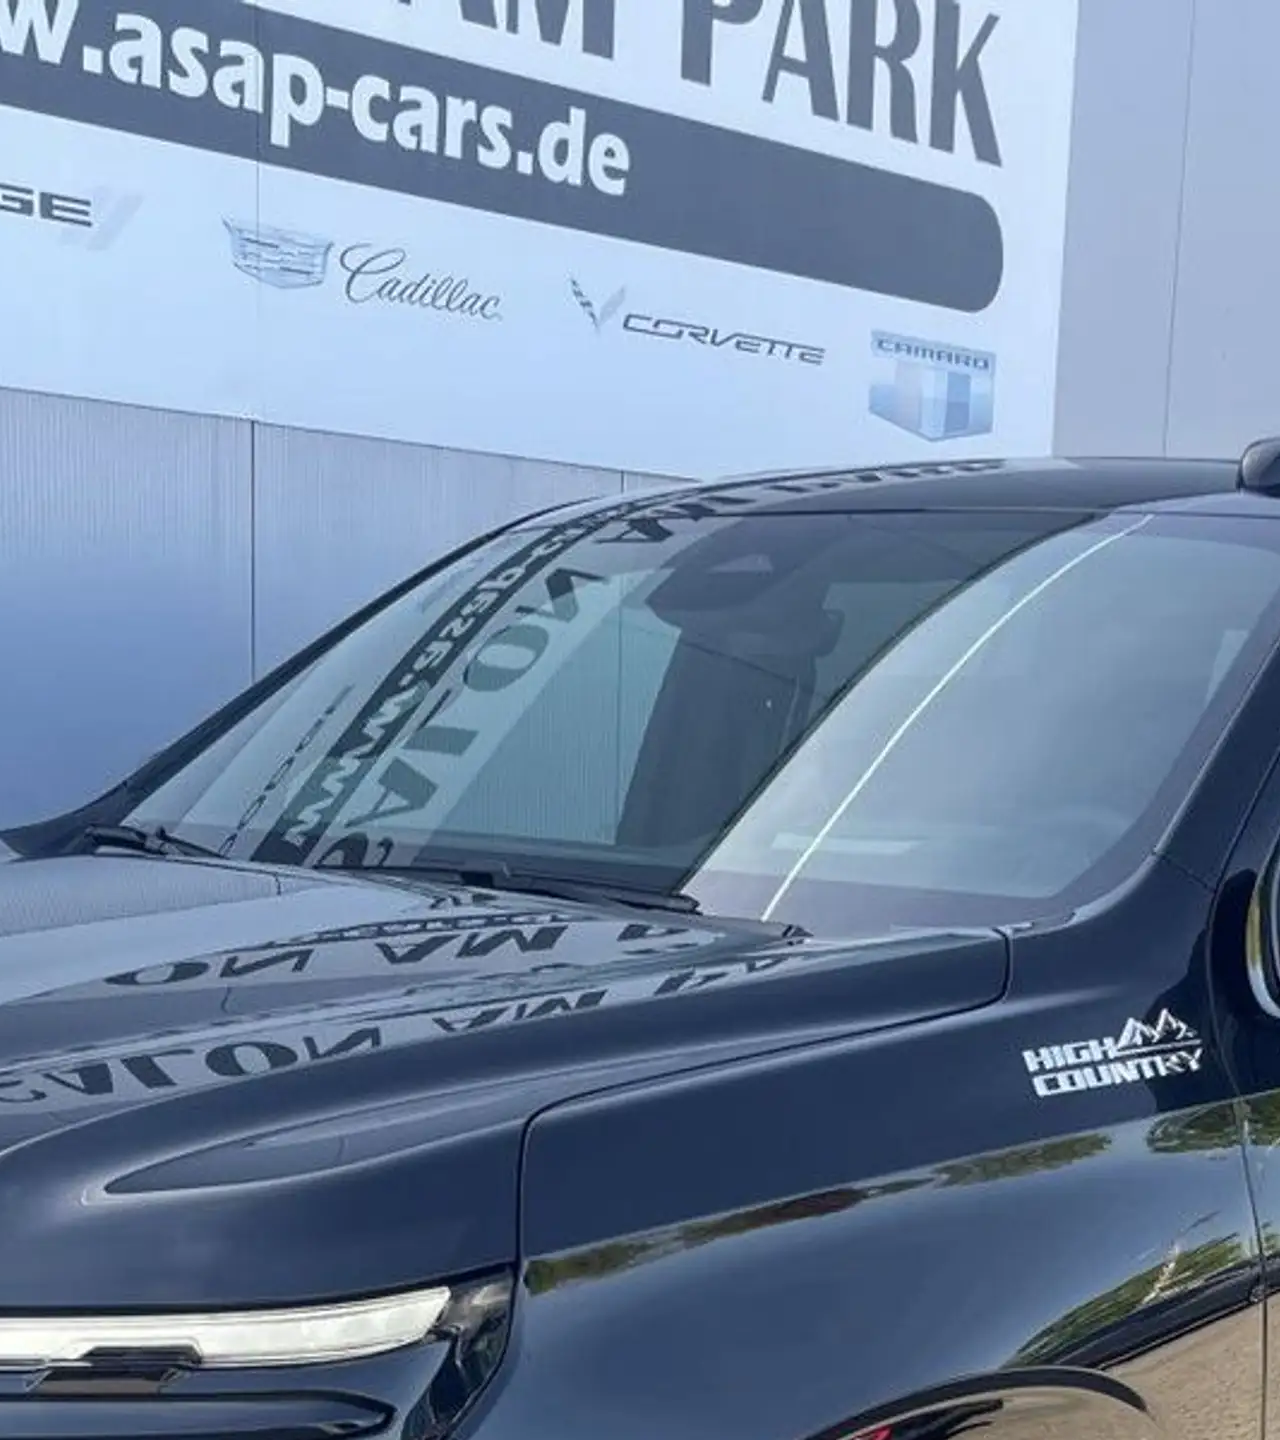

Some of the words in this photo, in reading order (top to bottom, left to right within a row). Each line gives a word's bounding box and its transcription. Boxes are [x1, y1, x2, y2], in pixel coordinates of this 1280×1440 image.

[339, 242, 503, 320] Cadillac
[623, 314, 826, 365] CORVETTE
[876, 337, 991, 371] CAMARO
[1023, 1035, 1122, 1071] HIGH
[1032, 1047, 1204, 1098] COUNTRY
